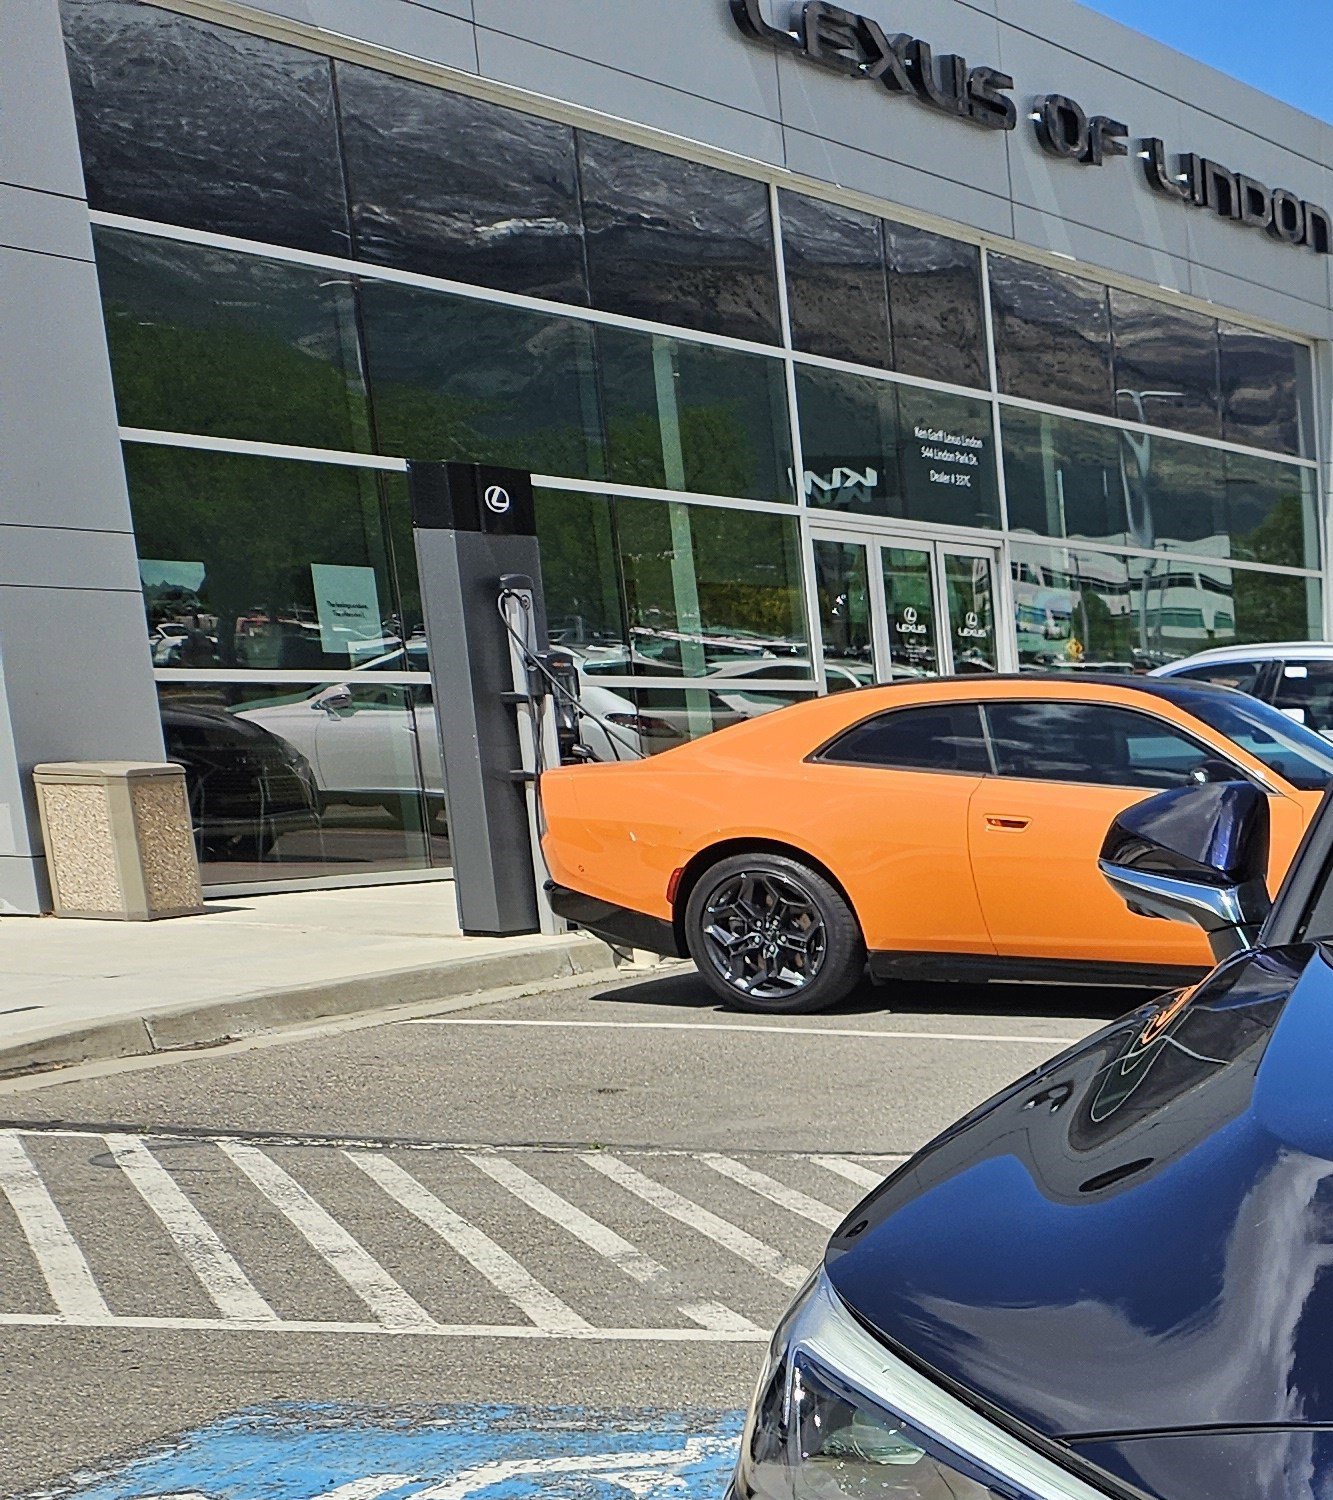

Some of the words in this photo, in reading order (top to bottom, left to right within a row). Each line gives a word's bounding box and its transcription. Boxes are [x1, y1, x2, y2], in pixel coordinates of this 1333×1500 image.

[730, 0, 1017, 130] LEXUS
[1029, 94, 1129, 166] OF
[896, 621, 927, 634] LEXUS
[958, 626, 987, 637] LEXUS
